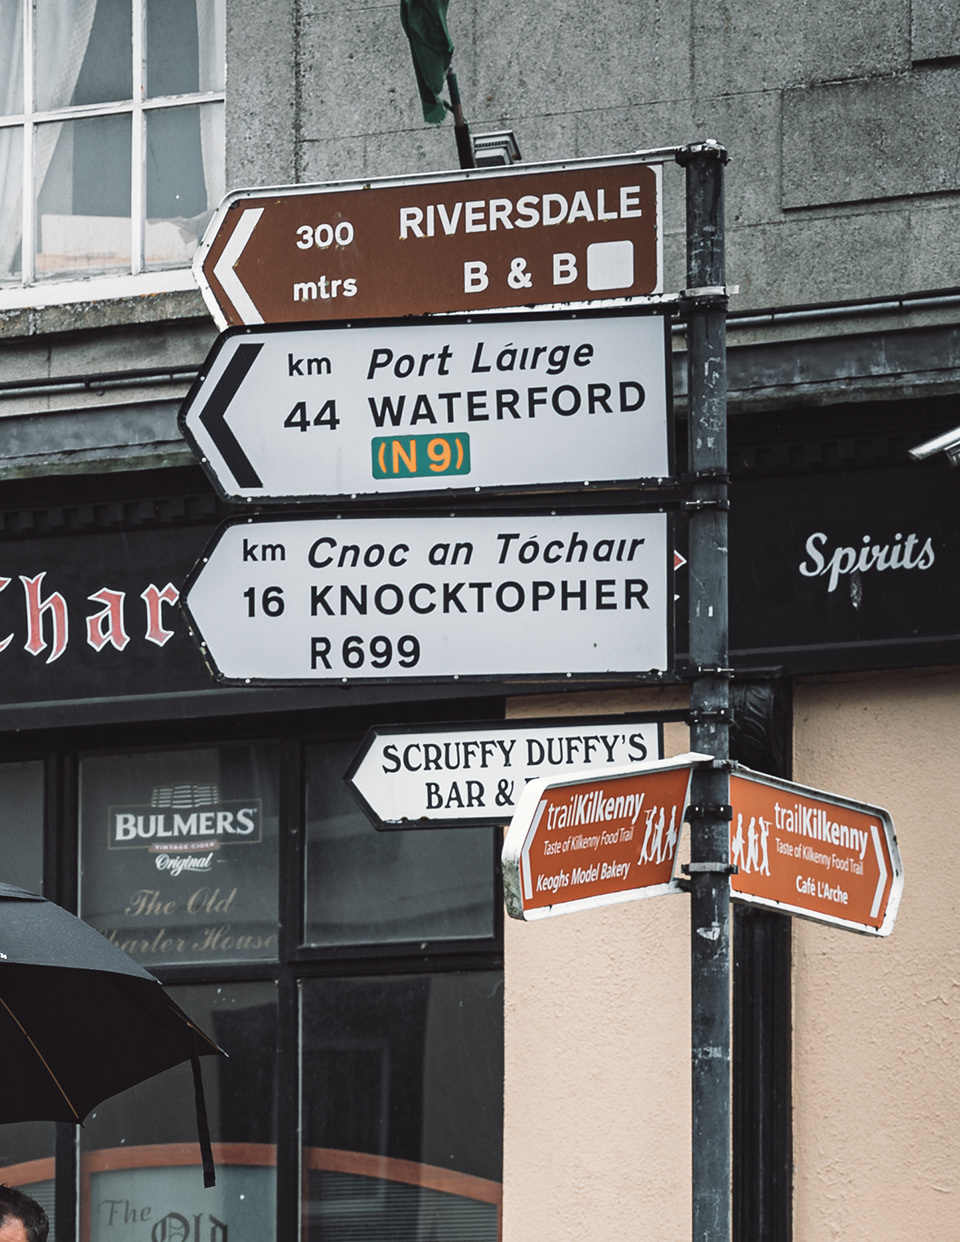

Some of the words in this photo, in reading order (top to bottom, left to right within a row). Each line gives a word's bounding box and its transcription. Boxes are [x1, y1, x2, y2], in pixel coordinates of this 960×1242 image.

[296, 221, 354, 250] 300
[400, 185, 642, 240] RIVERSDALE
[293, 276, 358, 300] mtrs
[464, 261, 488, 293] B
[507, 258, 532, 290] &
[553, 253, 578, 285] B
[288, 354, 331, 376] km
[367, 345, 453, 379] Port
[284, 400, 340, 432] 44
[368, 381, 646, 427] WATERFORD
[242, 539, 286, 562] km
[307, 536, 409, 568] Cnoc
[428, 542, 473, 566] an
[799, 532, 935, 593] Spirits
[243, 586, 285, 618] 16
[310, 579, 650, 616] KNOCKTOPHER
[382, 740, 517, 774] SCRUFFY
[526, 732, 648, 766] DUFFY'S
[425, 780, 485, 810] BAR
[495, 778, 515, 806] &
[547, 790, 645, 831] trailKilkenny
[115, 808, 255, 841] BULMERS
[543, 839, 561, 856] Taste
[562, 836, 571, 853] of
[570, 834, 600, 851] Kilkenny
[600, 829, 619, 846] Food
[620, 826, 634, 843] Trail
[774, 802, 868, 861] trailKilkenny
[155, 852, 214, 877] Original
[775, 838, 793, 857] Taste
[794, 843, 801, 859] of
[802, 845, 831, 870] Kilkenny
[831, 853, 849, 872] Food
[849, 858, 863, 876] Trail
[536, 870, 569, 893] Keoghs
[570, 863, 600, 886] Model
[600, 860, 630, 881] Bakery
[796, 875, 816, 896] Café
[817, 880, 848, 905] L'Arche
[124, 889, 176, 917] The
[186, 887, 238, 916] Old
[99, 927, 185, 953] harter
[193, 924, 277, 951] House
[98, 1199, 152, 1227] The
